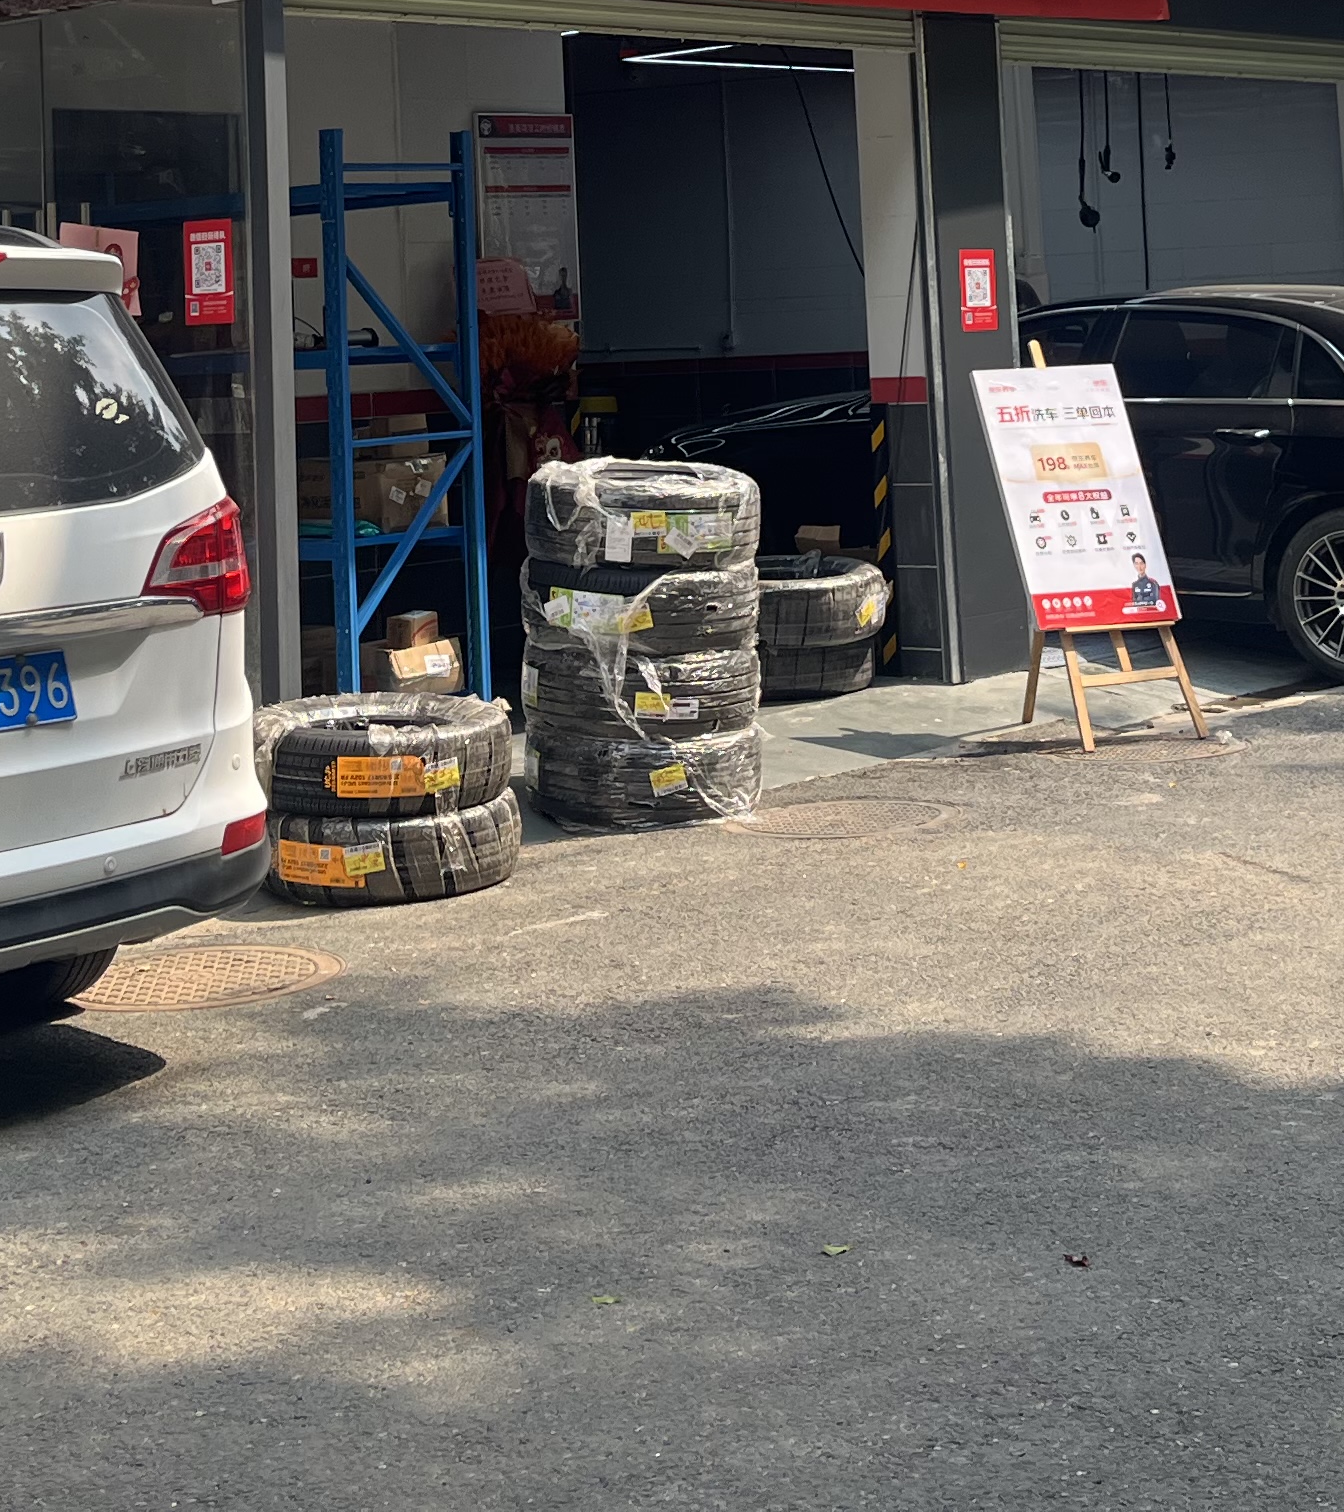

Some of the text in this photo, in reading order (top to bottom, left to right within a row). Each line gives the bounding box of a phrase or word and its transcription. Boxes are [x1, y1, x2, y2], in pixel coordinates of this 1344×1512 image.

[995, 405, 1116, 424] 五折洗车 三单回本
